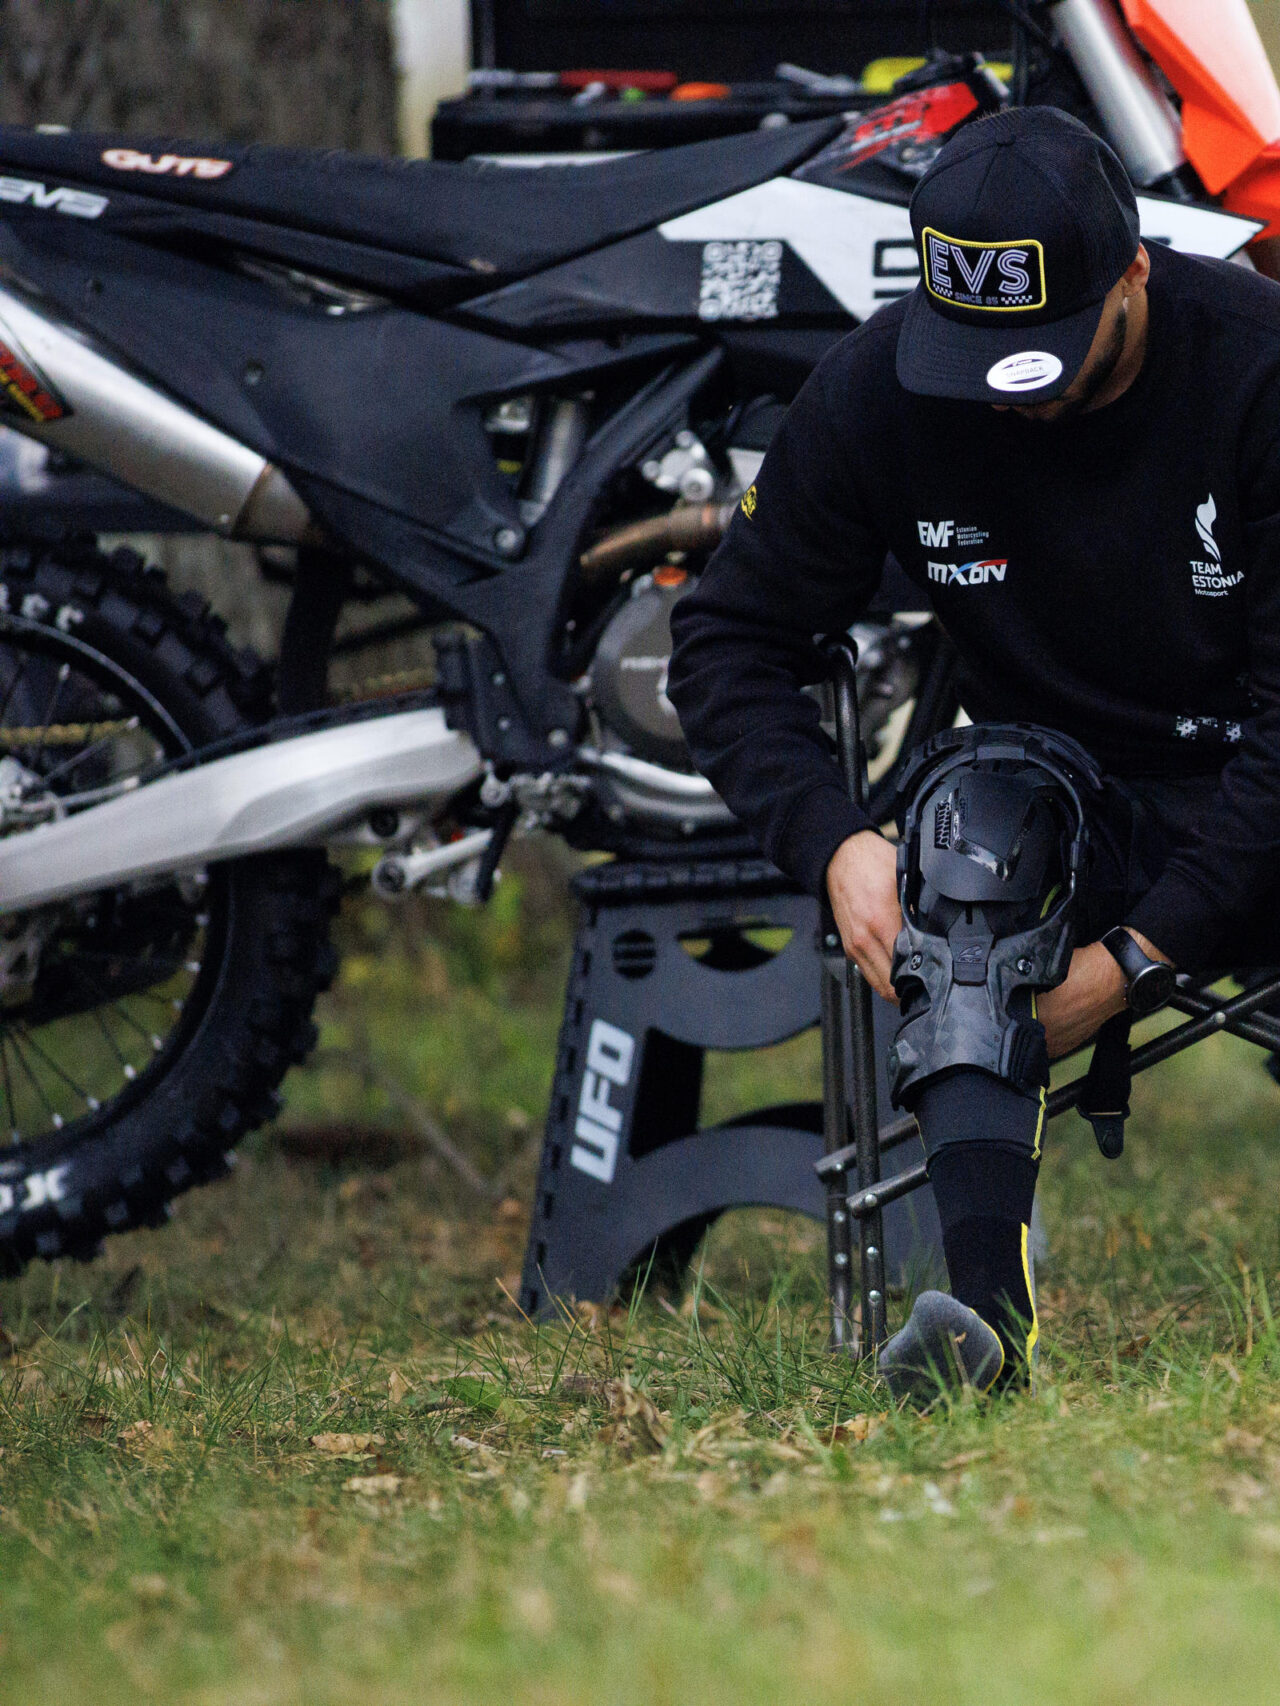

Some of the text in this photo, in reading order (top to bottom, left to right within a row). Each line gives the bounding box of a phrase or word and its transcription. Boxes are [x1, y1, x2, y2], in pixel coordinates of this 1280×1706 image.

[102, 148, 233, 179] GUTS
[928, 235, 1031, 295] EVS
[917, 520, 955, 548] EMF
[1189, 561, 1222, 575] TEAM
[1191, 571, 1244, 588] ESTONIA
[569, 1018, 636, 1185] UFO
